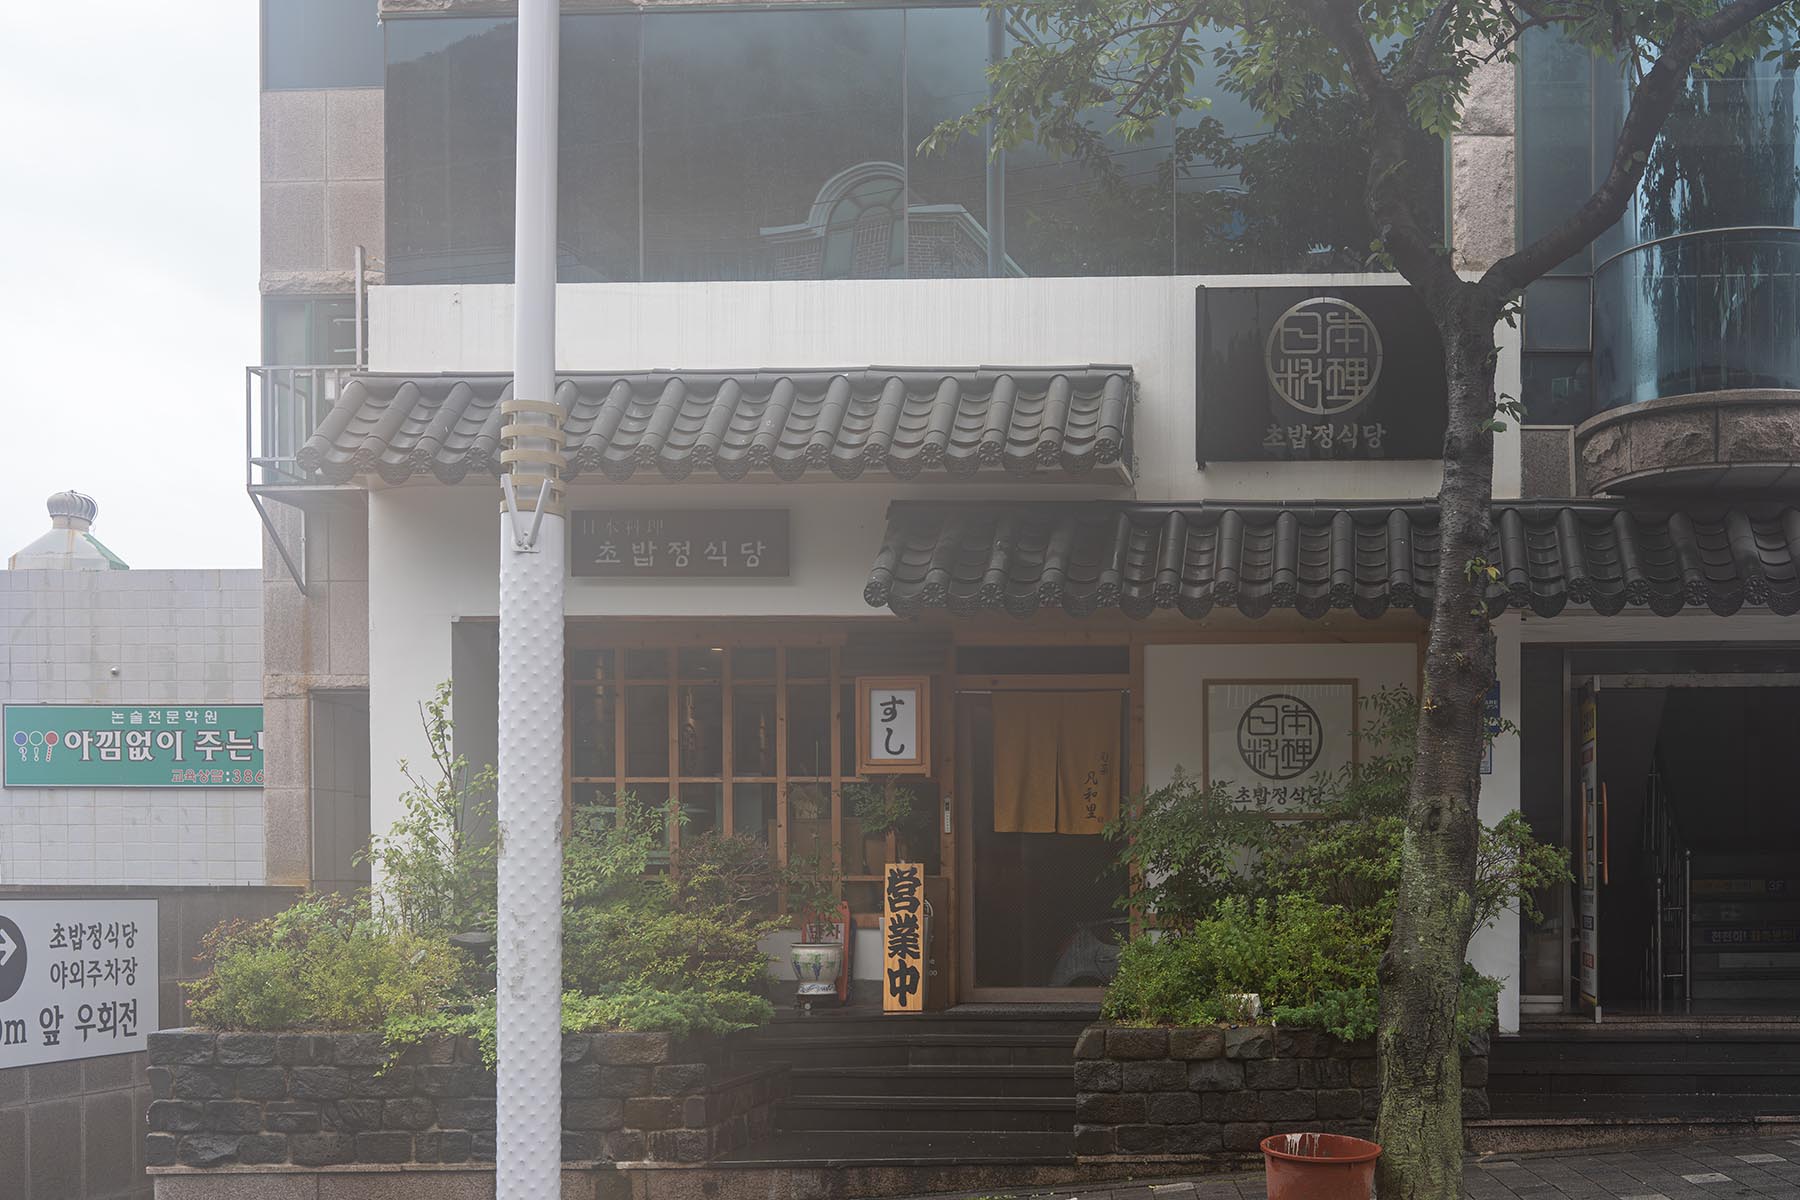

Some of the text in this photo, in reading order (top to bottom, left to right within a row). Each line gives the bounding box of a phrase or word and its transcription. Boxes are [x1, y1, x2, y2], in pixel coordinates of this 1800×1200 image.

[1262, 423, 1387, 449] 초밥정식당
[595, 540, 766, 568] 초밥정식당
[111, 710, 218, 724] 논술전문학원
[879, 694, 905, 756] すし
[64, 730, 264, 762] 아낌없이 주는
[49, 921, 138, 952] 초밥정식당
[886, 866, 922, 1008] 営業中
[50, 956, 138, 990] 야외주차장
[0, 998, 138, 1046] m 앞 우회전
